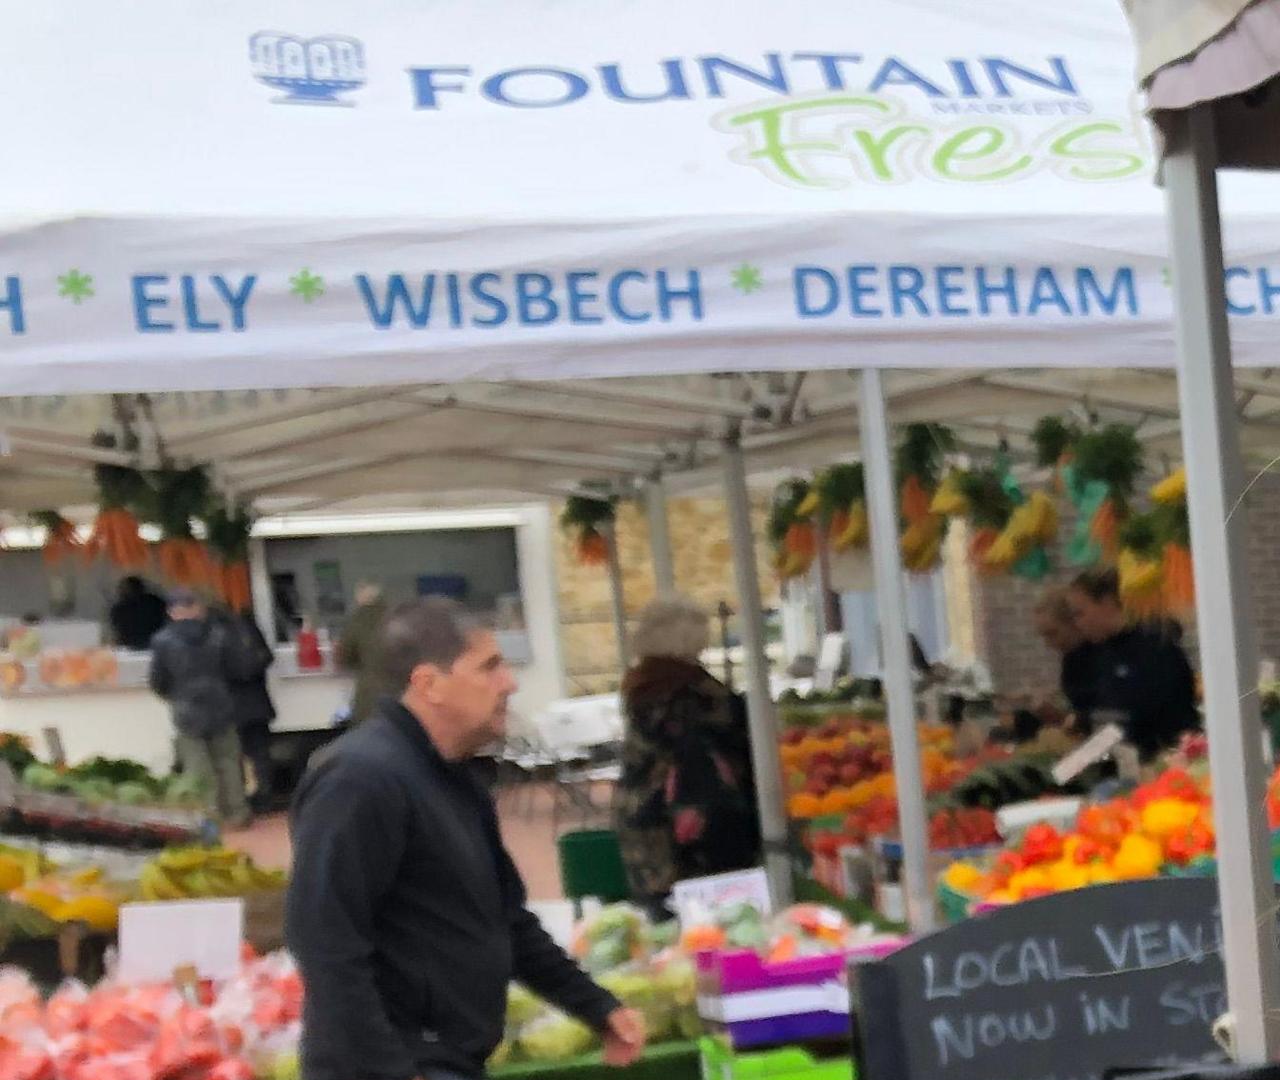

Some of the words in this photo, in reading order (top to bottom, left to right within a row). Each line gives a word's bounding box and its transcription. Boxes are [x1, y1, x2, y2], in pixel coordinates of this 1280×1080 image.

[405, 53, 1083, 110] FOUNTAIN
[130, 272, 257, 334] ELY
[354, 265, 704, 331] WISBECH
[793, 265, 1140, 318] DEREHAM
[922, 937, 1083, 1000] LOCAL
[931, 1005, 1055, 1067] NOW
